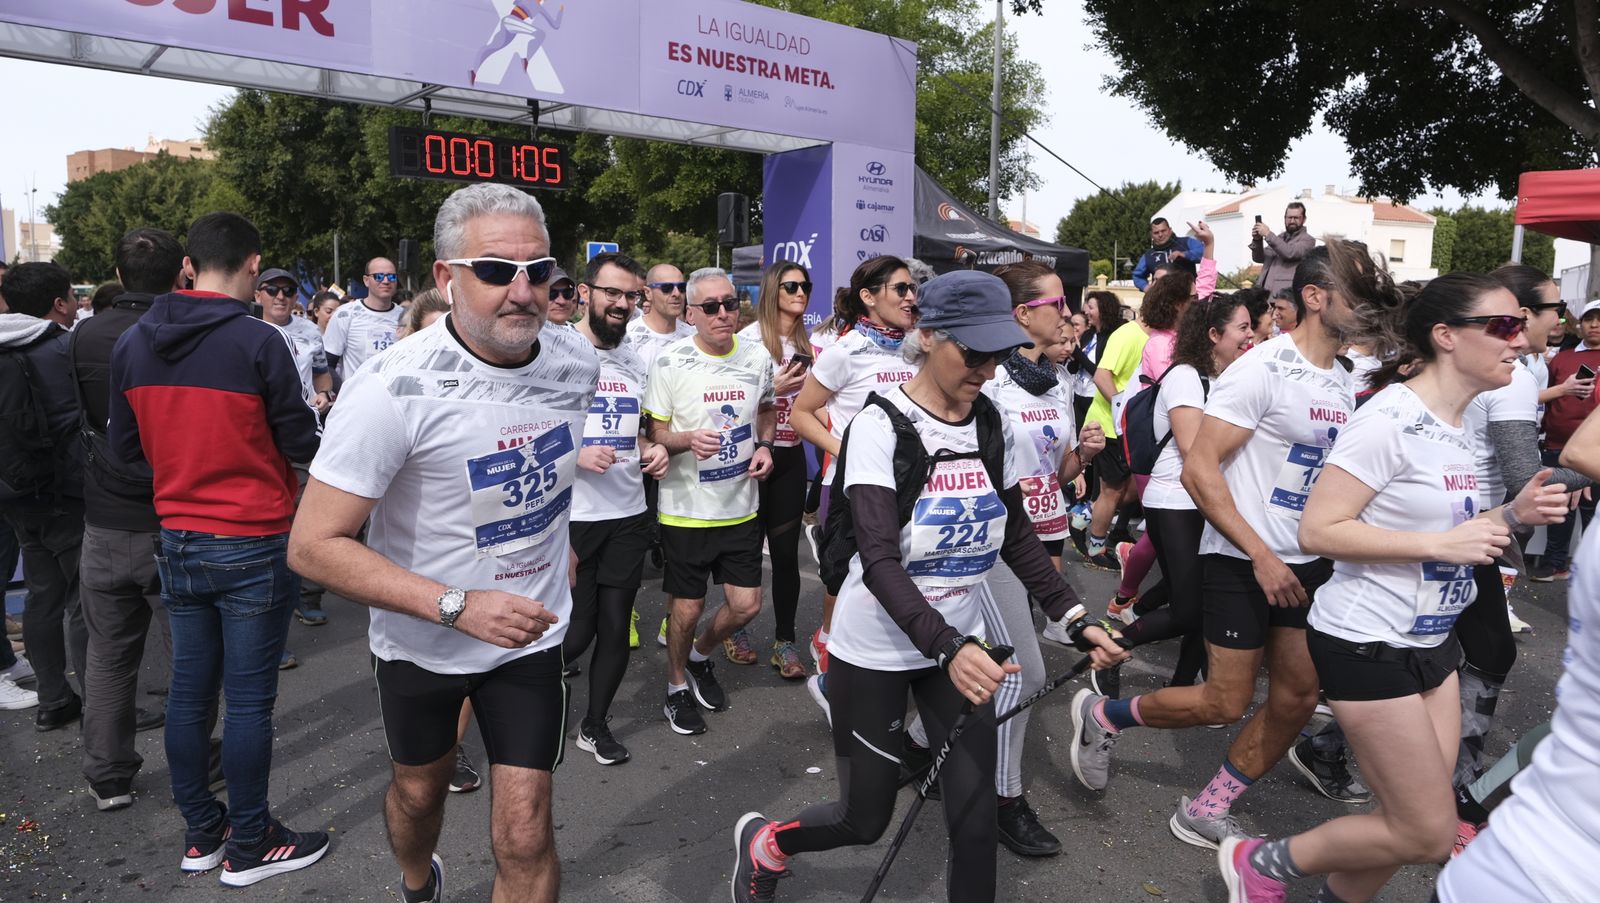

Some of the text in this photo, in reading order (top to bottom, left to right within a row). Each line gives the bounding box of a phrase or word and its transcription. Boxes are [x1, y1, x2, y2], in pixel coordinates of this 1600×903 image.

[698, 15, 811, 55] LA IGUALDAD
[668, 41, 835, 90] ES NUESTRA META.
[677, 80, 707, 98] CDX
[738, 88, 770, 101] ALMERÍA
[858, 176, 893, 186] HYUNDAI
[867, 202, 895, 212] cajamar
[803, 312, 822, 325] ERÍA
[876, 371, 913, 383] MUJER
[703, 390, 746, 403] MUJER
[602, 414, 622, 430] 57
[1021, 408, 1059, 423] MUJER
[1309, 407, 1348, 425] MUJER
[500, 422, 540, 436] CARRERA
[541, 420, 552, 430] DE
[718, 445, 738, 461] 58
[486, 462, 516, 475] MUJER
[933, 461, 962, 471] ARRERA
[963, 461, 973, 470] DE
[502, 462, 557, 508] 325
[928, 471, 987, 493] MUJER
[525, 496, 545, 510] PEPE
[1028, 492, 1058, 516] 993
[929, 508, 956, 516] MUJER
[935, 521, 989, 551] 224
[494, 572, 503, 581] ES
[504, 567, 537, 579] NUESTRA
[1438, 580, 1472, 605] 150
[920, 741, 951, 797] FIZAN
